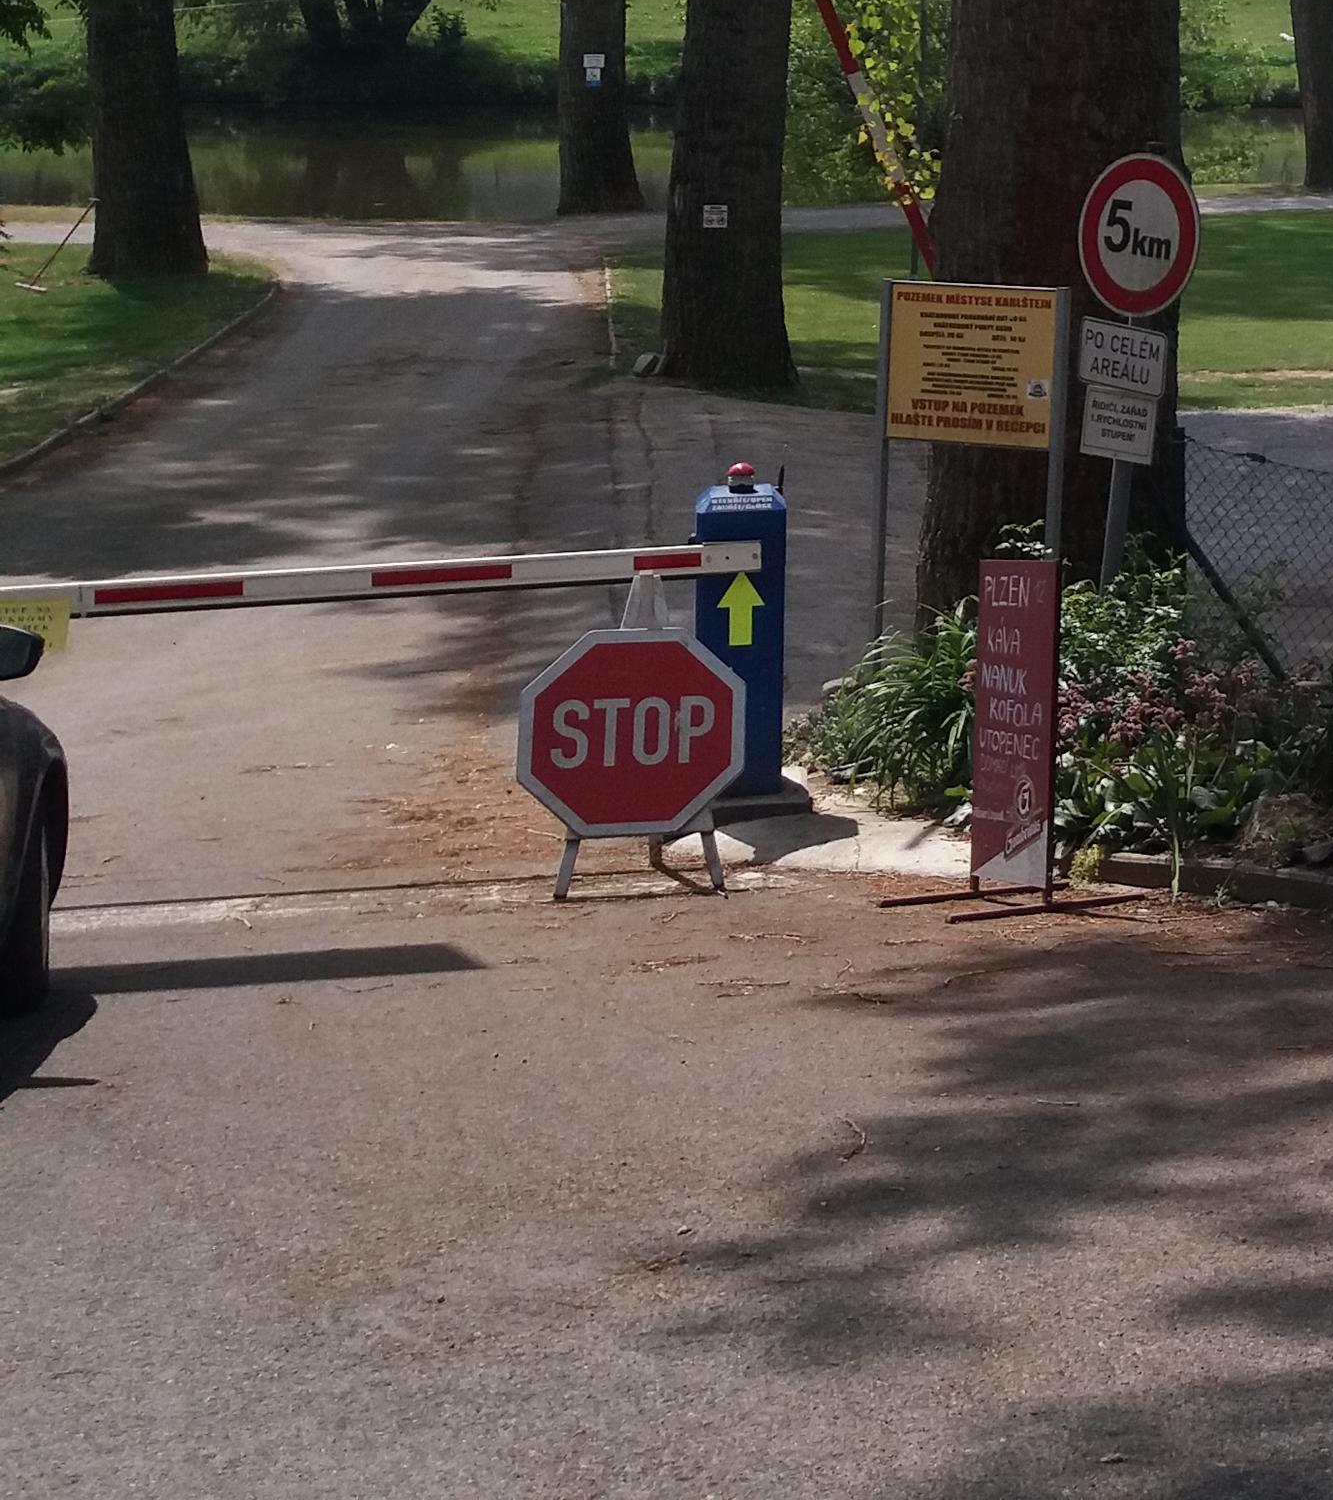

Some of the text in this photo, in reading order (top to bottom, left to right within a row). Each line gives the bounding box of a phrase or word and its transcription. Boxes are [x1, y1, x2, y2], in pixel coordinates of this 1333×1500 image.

[897, 291, 943, 304] POZEMEK
[1085, 328, 1160, 362] PO CELÉM
[1090, 356, 1150, 385] AREÁLU
[891, 412, 1046, 434] HLAŠTE PROSÍM V RECEPCI
[911, 399, 1024, 416] VSTUP NA POZEMEK
[988, 616, 1020, 654] KÁVA
[981, 662, 1027, 695] NANUK
[989, 697, 1042, 727] KOFOLA
[550, 694, 716, 770] STOP
[979, 727, 1041, 760] UTOPENEC
